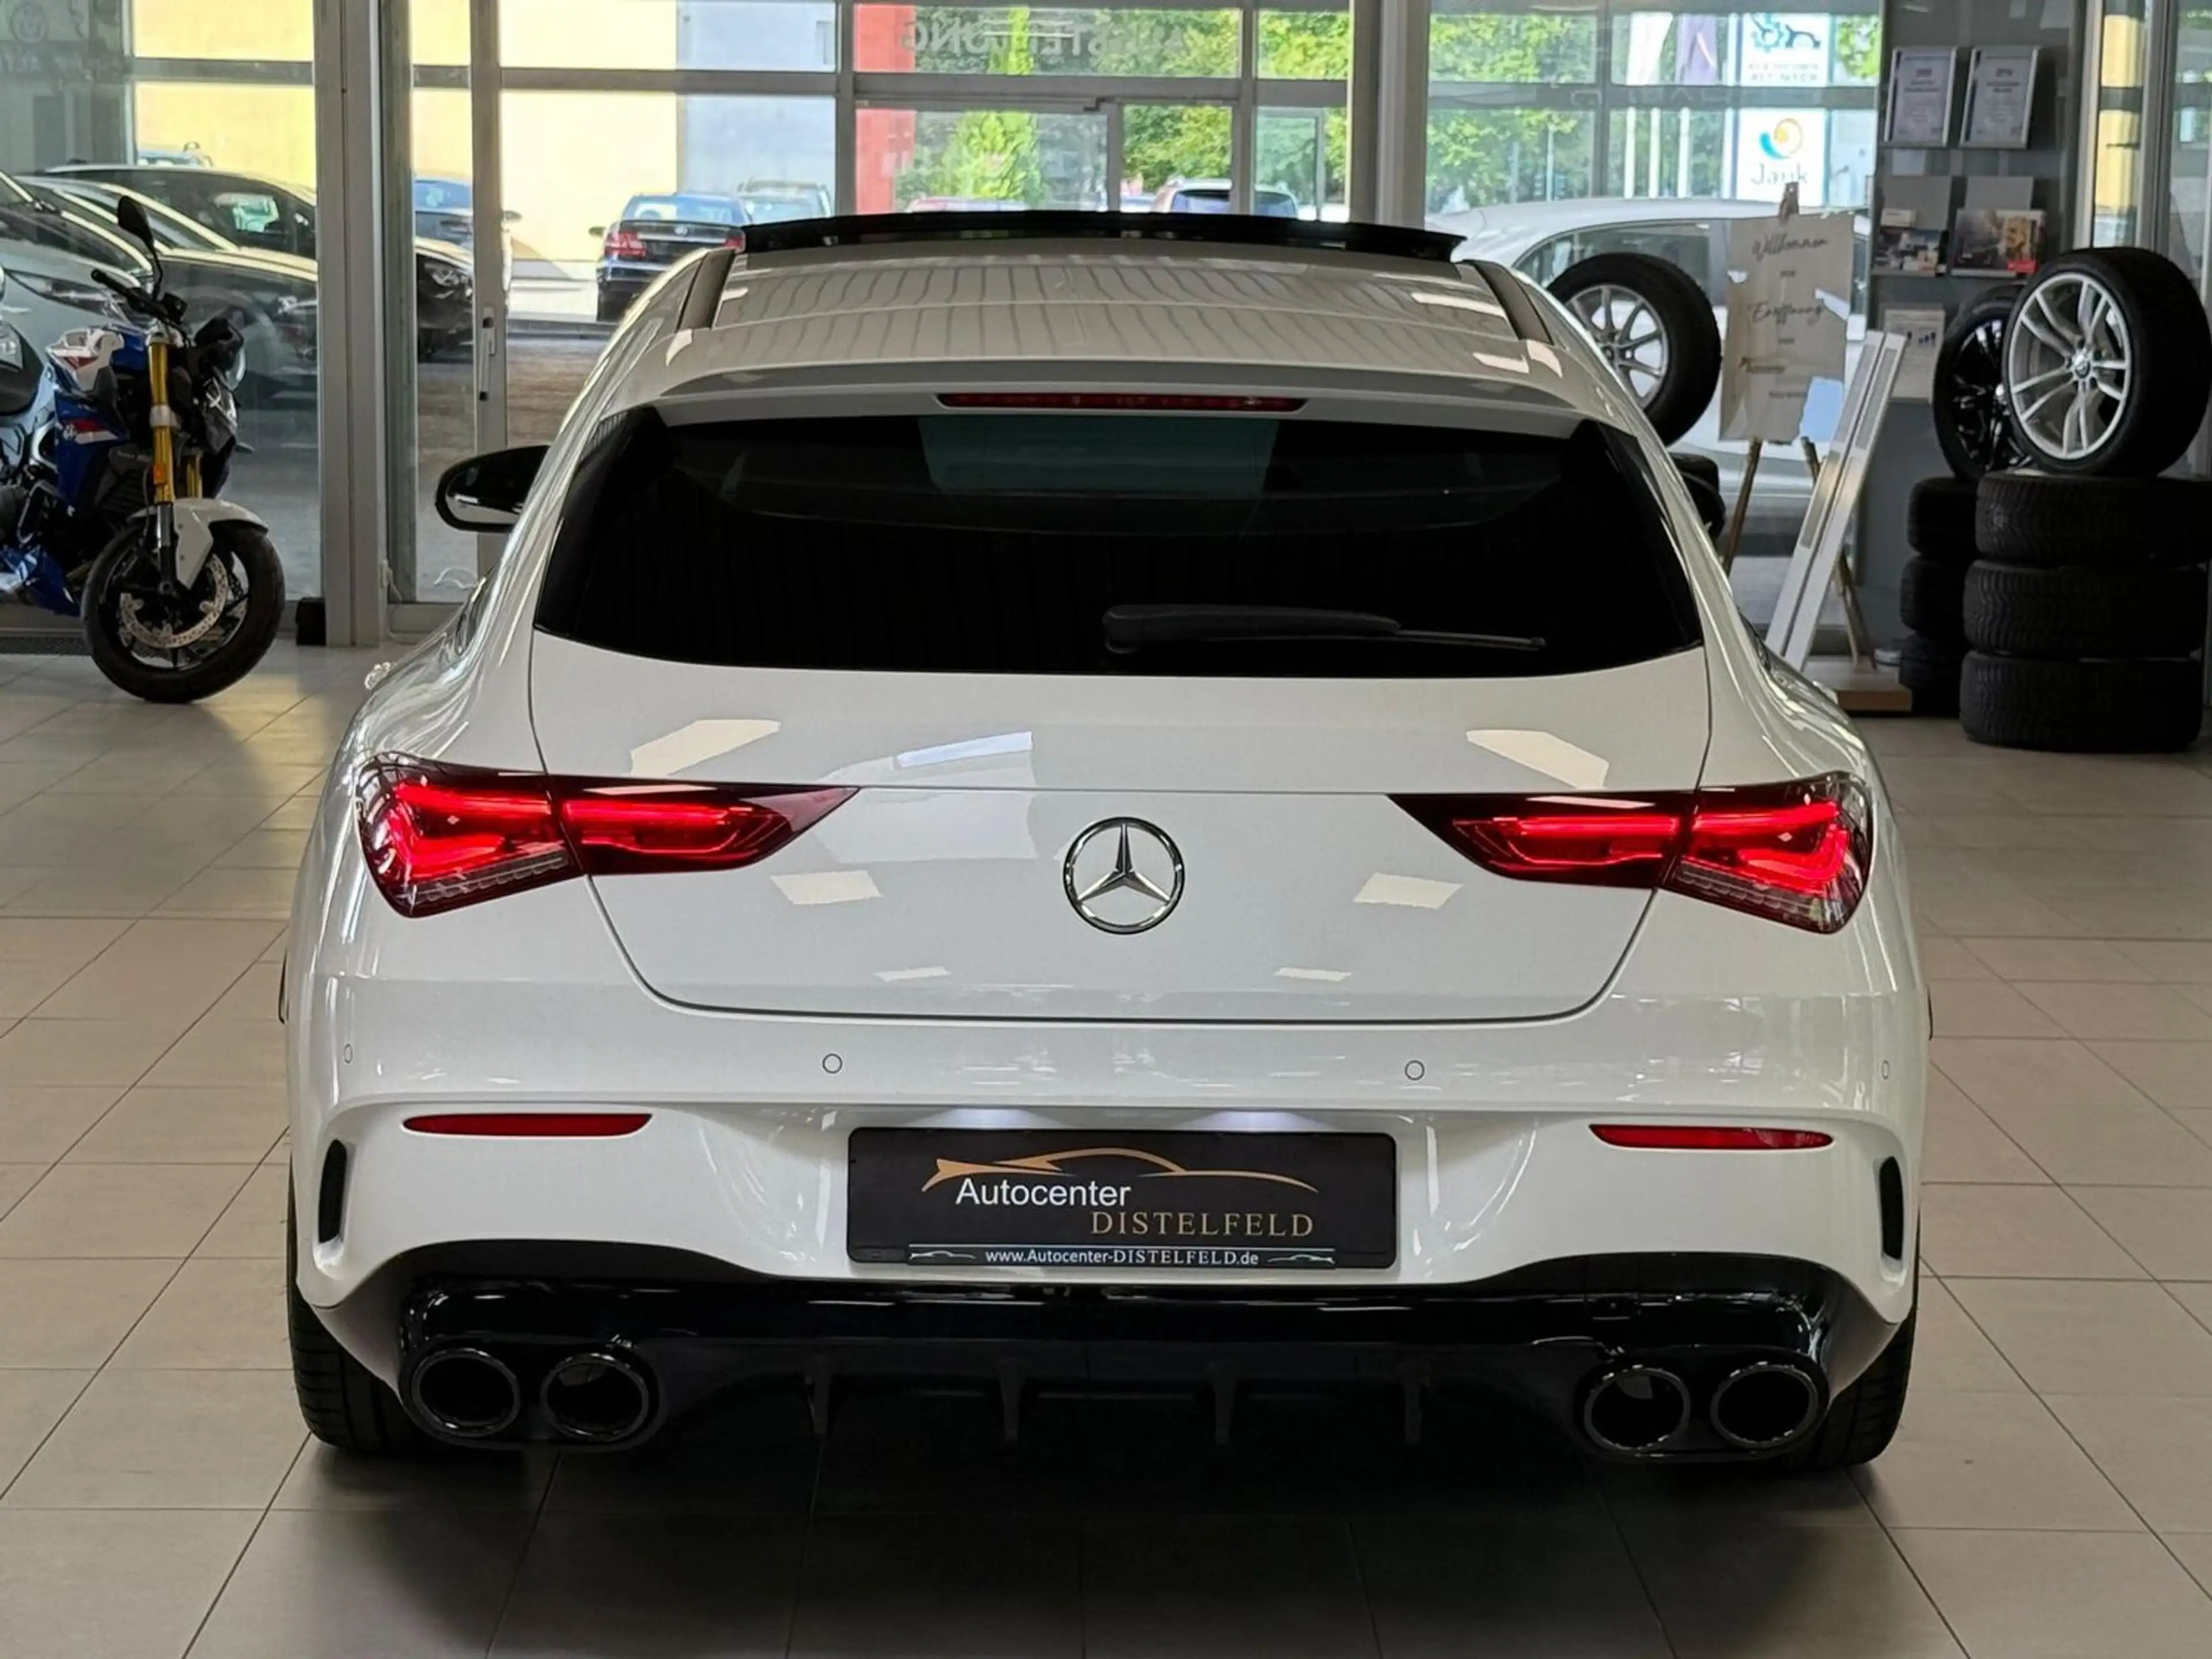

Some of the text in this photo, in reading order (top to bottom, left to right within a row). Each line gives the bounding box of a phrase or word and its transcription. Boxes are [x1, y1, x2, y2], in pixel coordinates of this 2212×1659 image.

[955, 1178, 1132, 1206] Autocenter
[1090, 1211, 1313, 1237] DISTELFELD
[985, 1249, 1259, 1265] www.Autocenter-DISTELFELD.de
